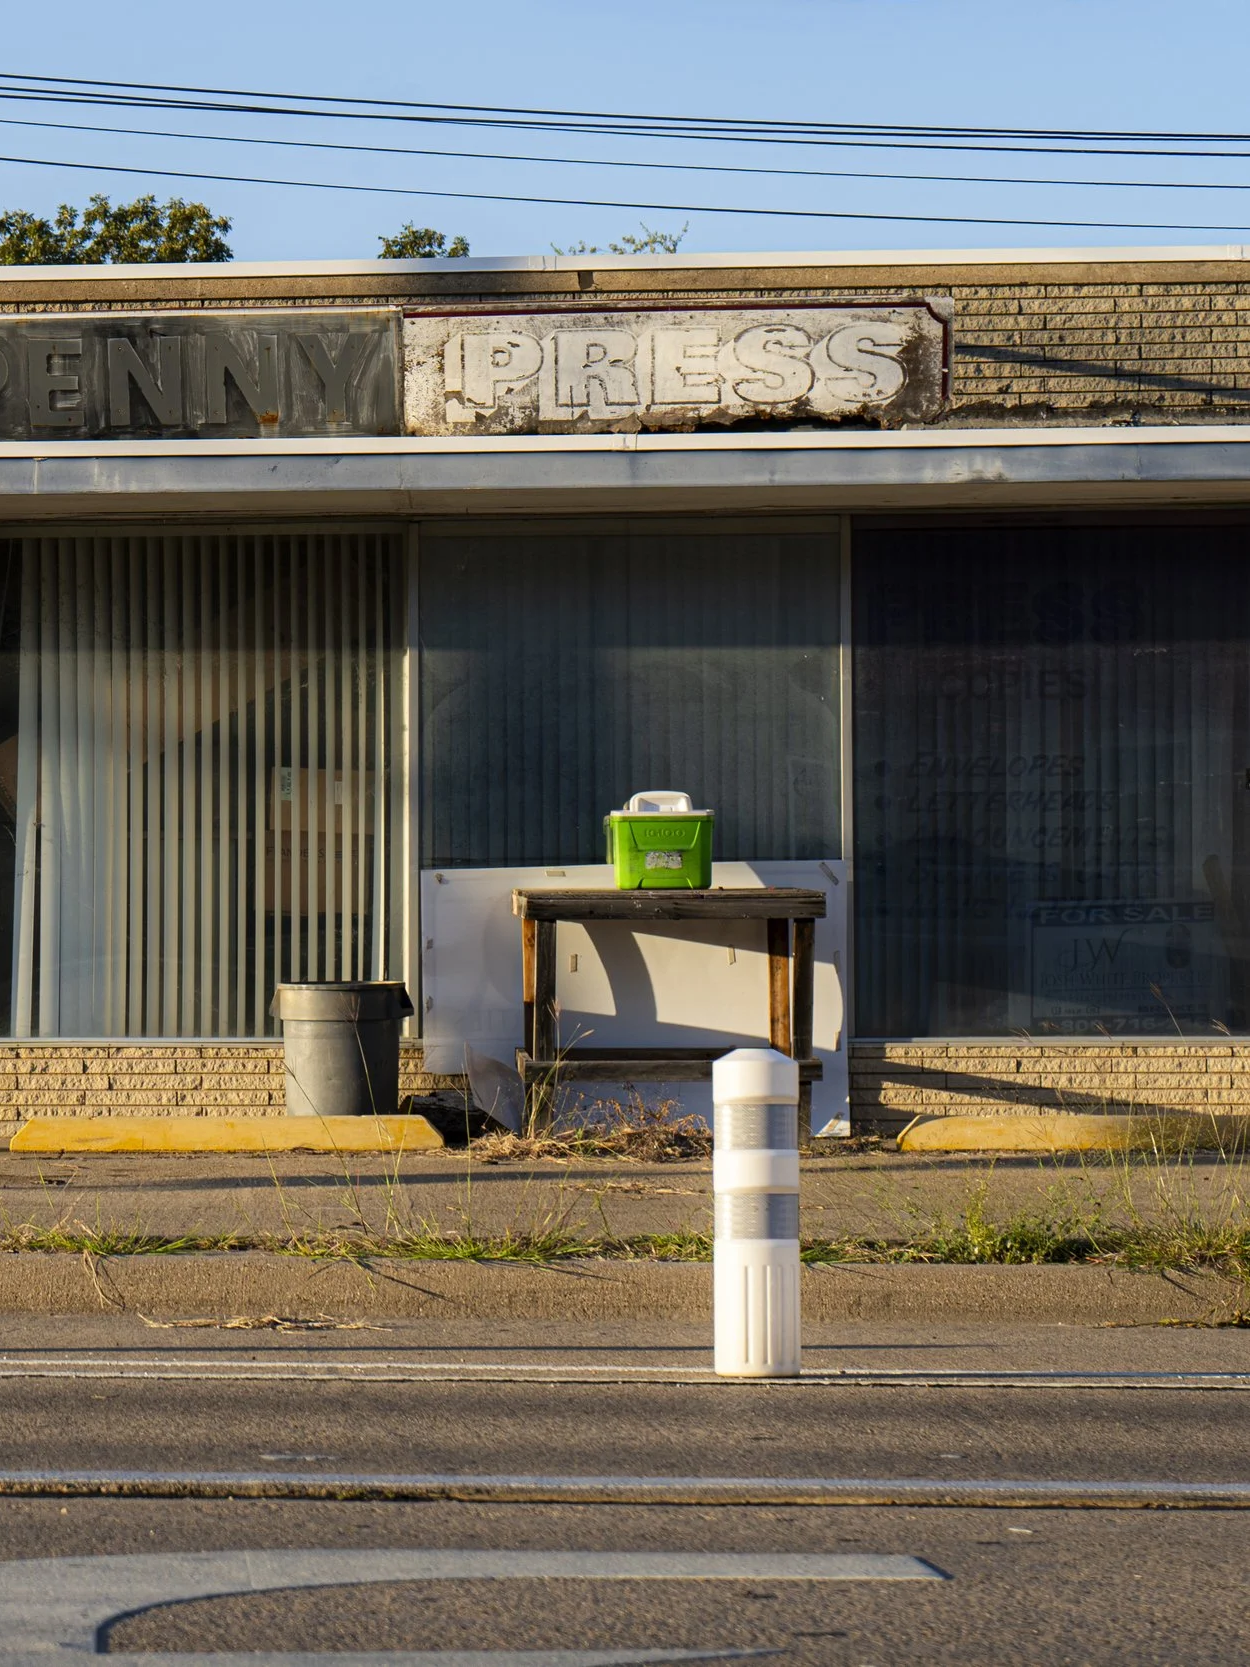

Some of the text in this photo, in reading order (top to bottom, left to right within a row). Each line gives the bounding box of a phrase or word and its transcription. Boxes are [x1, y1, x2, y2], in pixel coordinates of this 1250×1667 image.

[445, 323, 908, 422] PRESS
[938, 668, 1088, 698] COPIES
[907, 751, 1086, 778] ENVELOPES
[907, 790, 1118, 813] LETTERHEADS
[1039, 907, 1111, 924] FOR
[1123, 904, 1213, 921] SALE
